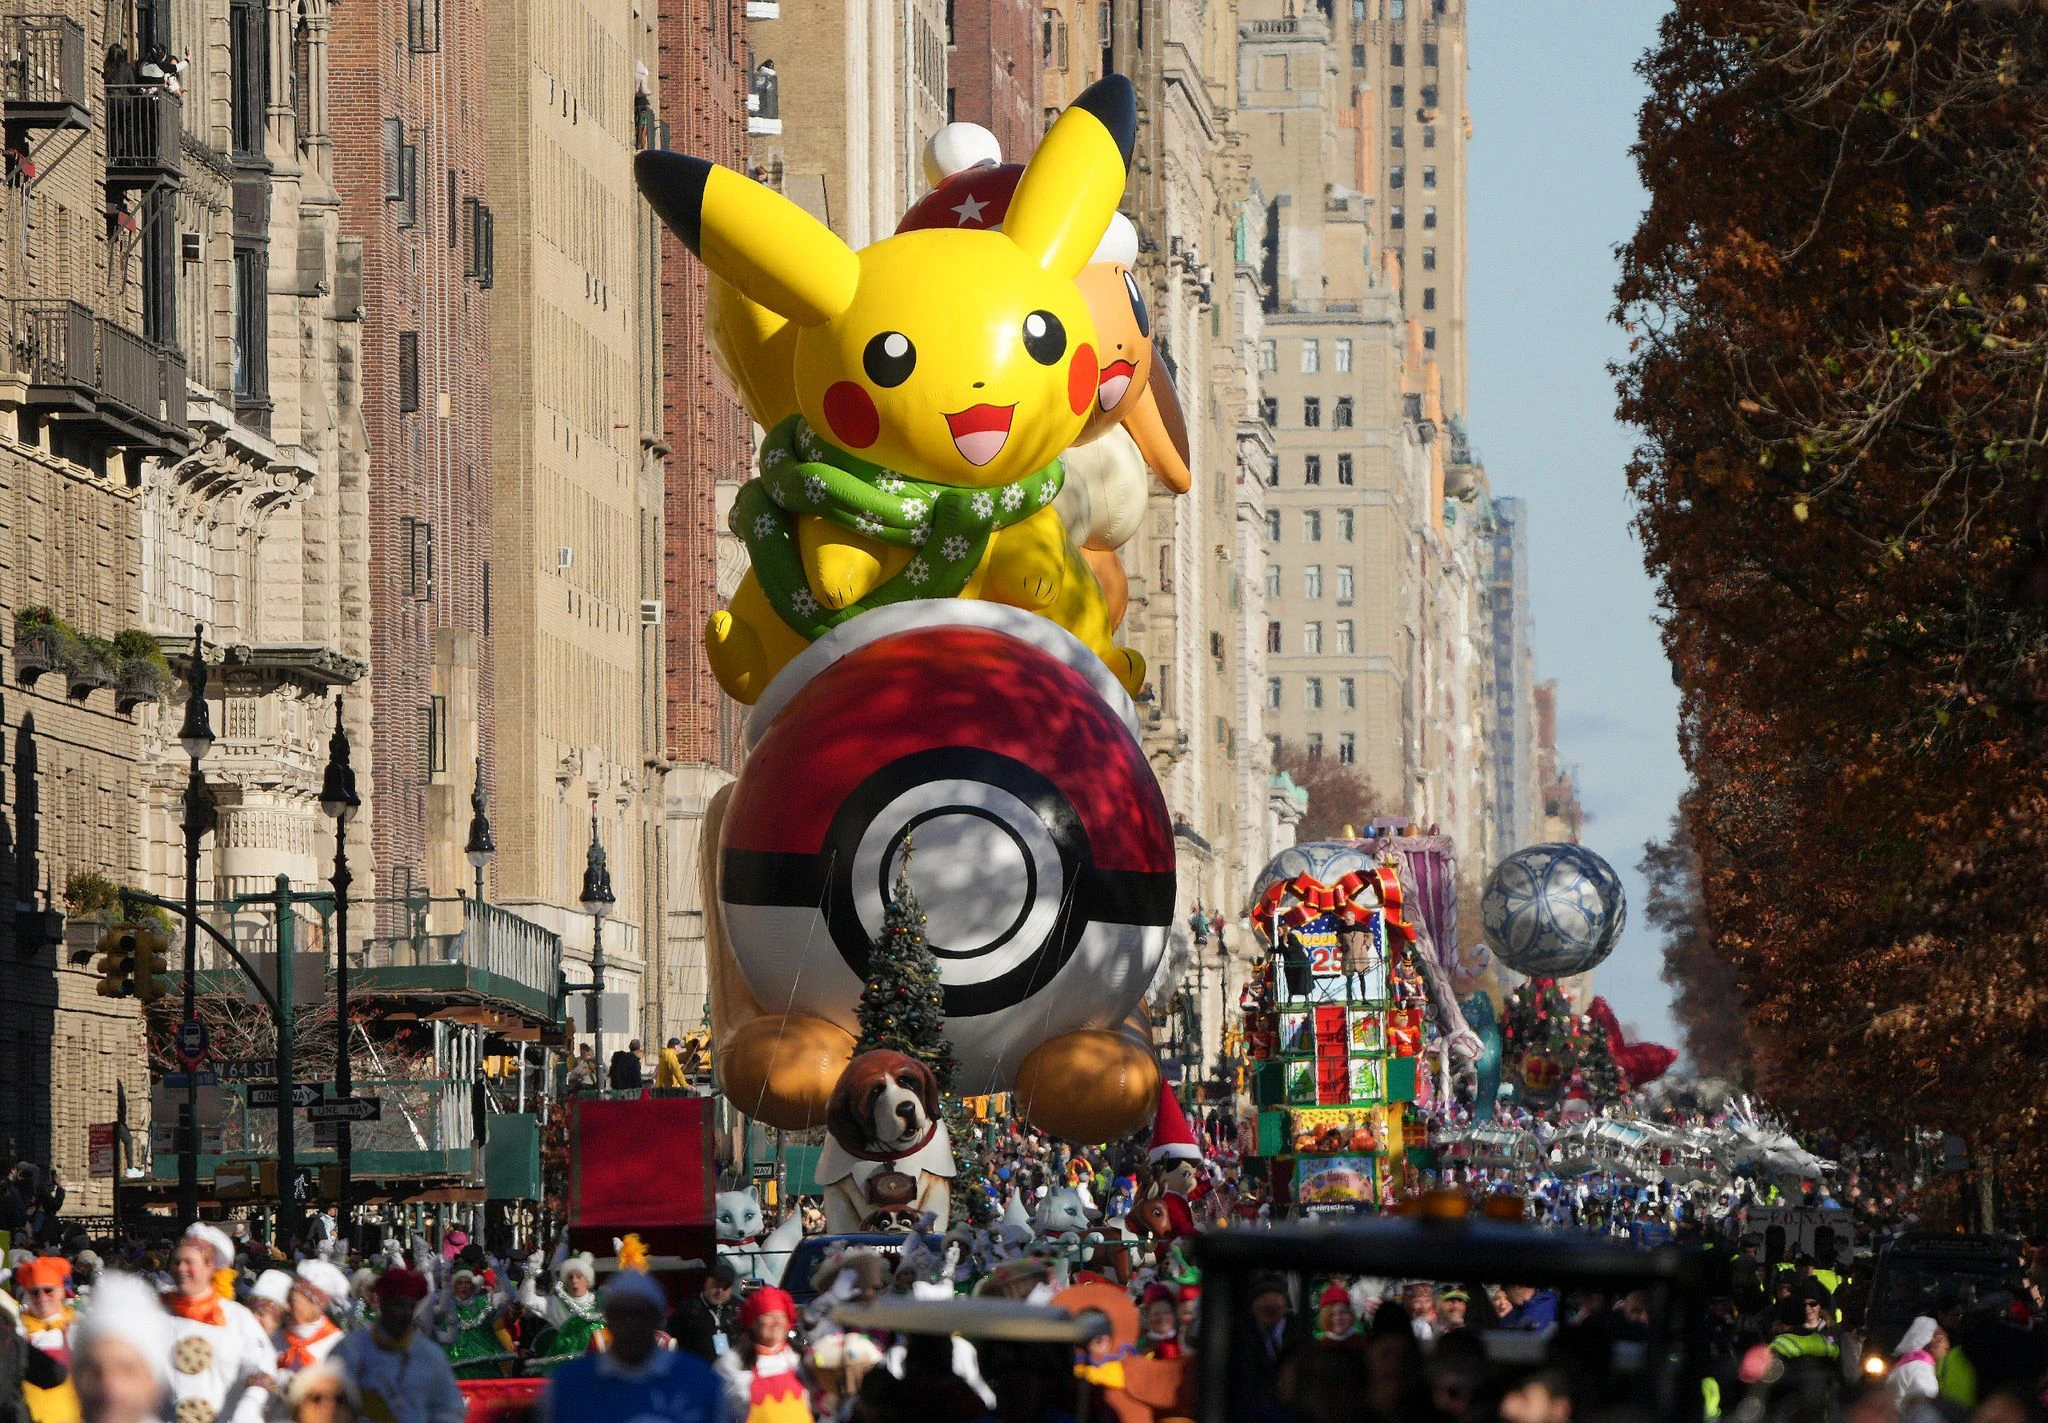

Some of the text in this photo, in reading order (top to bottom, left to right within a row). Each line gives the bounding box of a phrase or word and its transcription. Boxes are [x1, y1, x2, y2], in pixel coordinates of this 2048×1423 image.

[1312, 948, 1342, 972] 25
[213, 1061, 272, 1077] W 64 ST
[257, 1090, 279, 1101] ONE
[317, 1105, 370, 1115] ONE WAY
